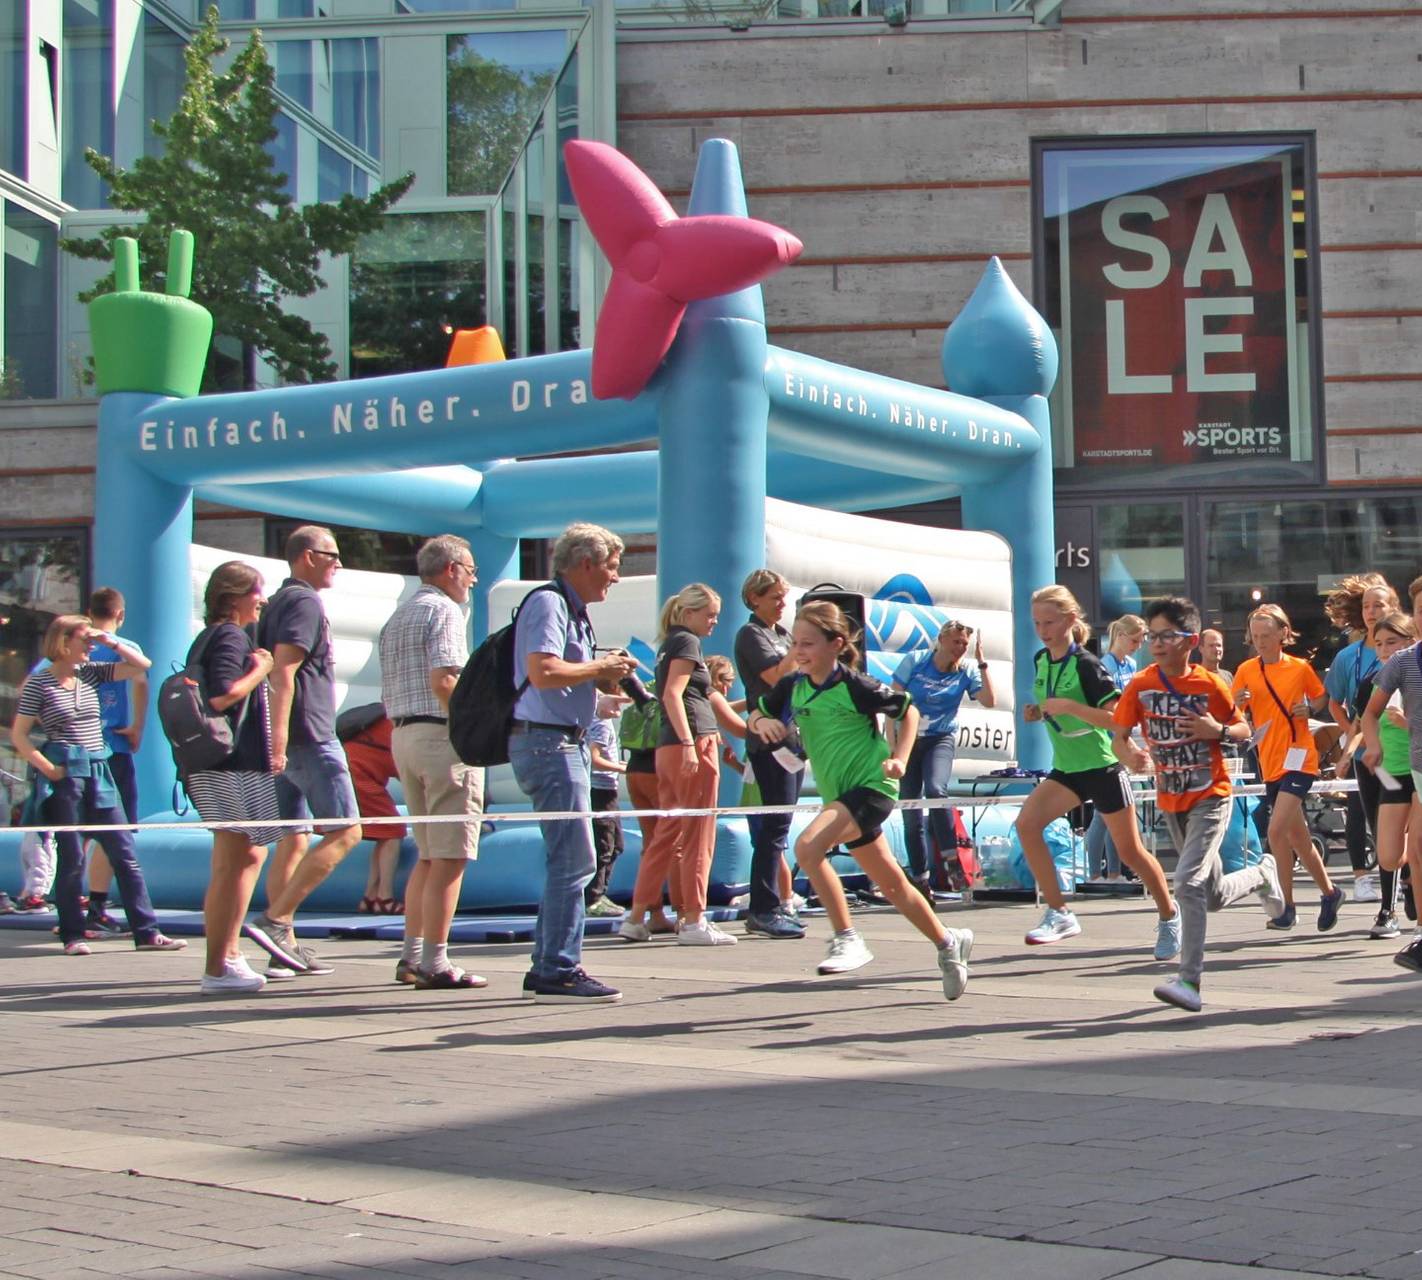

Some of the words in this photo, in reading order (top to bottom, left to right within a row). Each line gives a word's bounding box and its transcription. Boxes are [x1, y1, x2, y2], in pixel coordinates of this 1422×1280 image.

[1101, 193, 1253, 290] SA
[1105, 296, 1257, 394] LE
[139, 411, 306, 451] Einfach.
[333, 394, 480, 434] Näher.
[785, 372, 876, 419] Einfach.
[889, 402, 957, 437] Näher.
[968, 420, 1021, 449] Dran.
[1197, 427, 1282, 447] SPORTS
[1237, 447, 1256, 455] Sport
